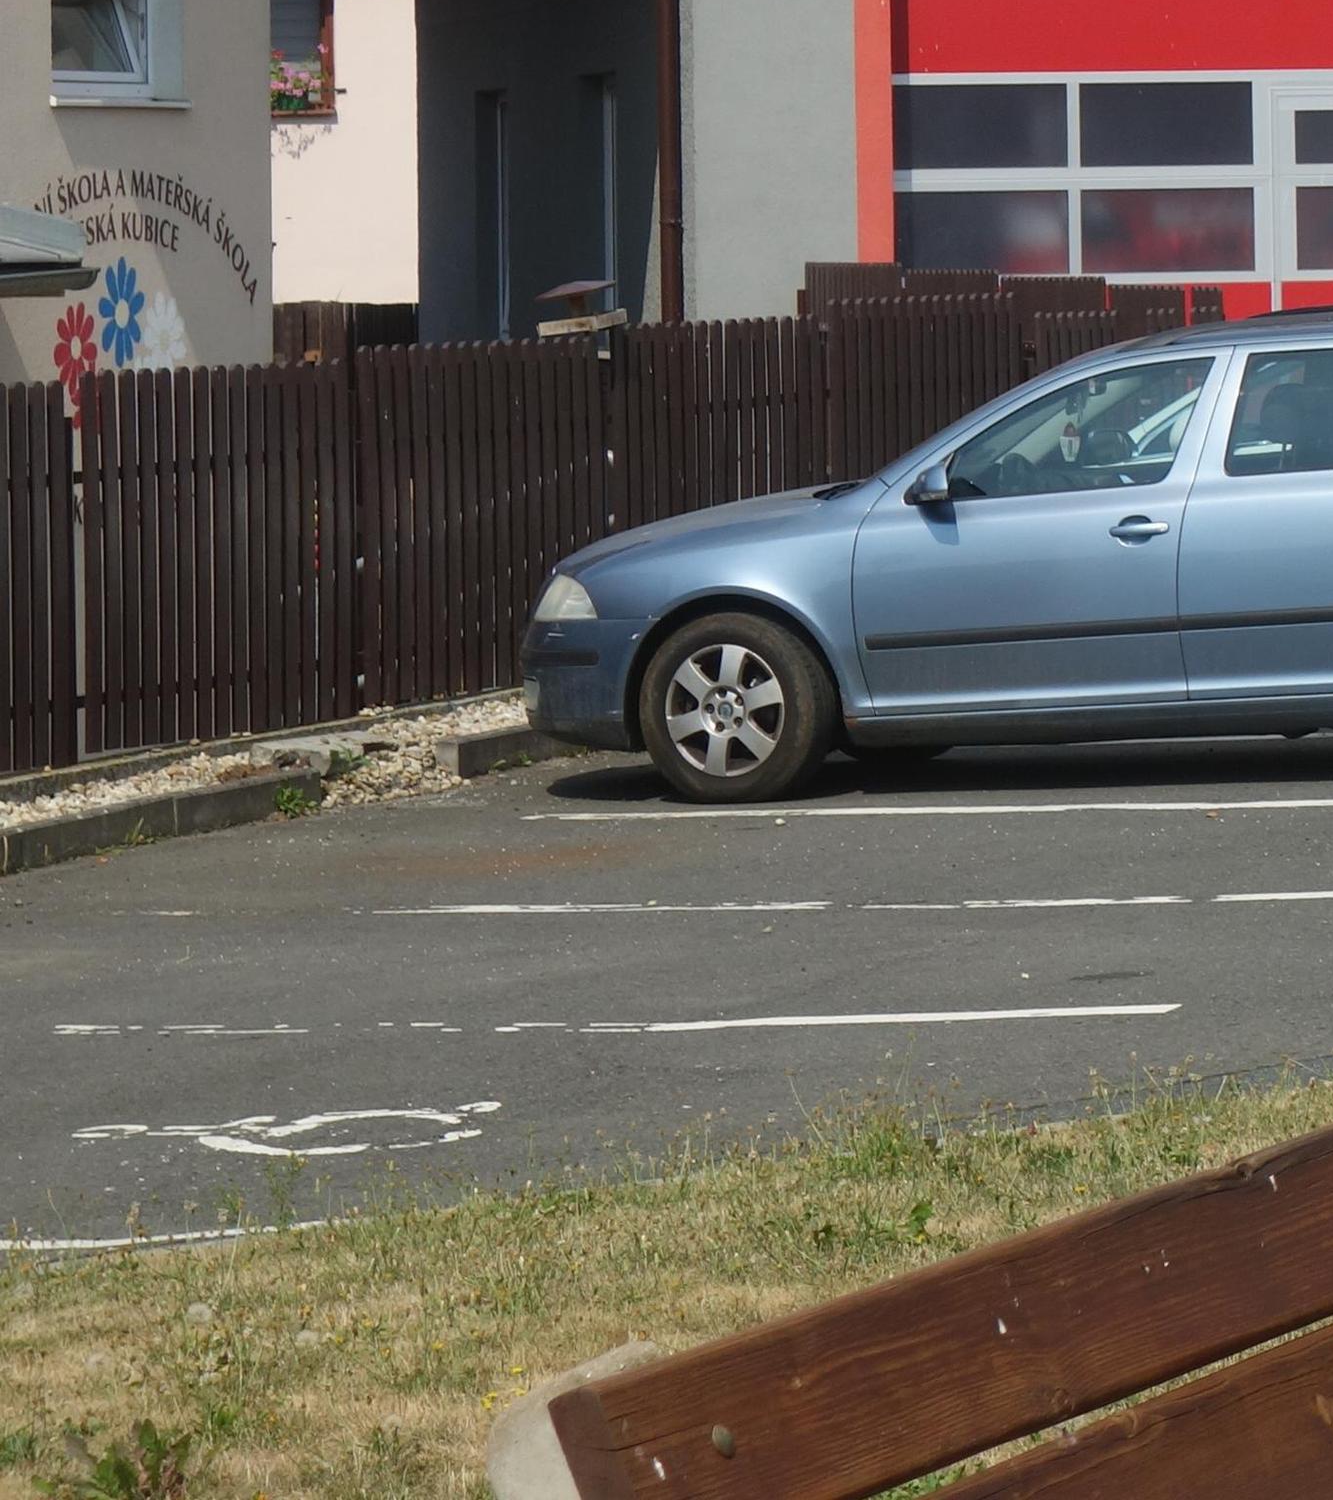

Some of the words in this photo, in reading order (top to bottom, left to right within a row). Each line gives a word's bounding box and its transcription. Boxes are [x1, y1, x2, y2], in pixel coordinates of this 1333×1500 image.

[57, 170, 111, 214] ŠKOLA
[115, 168, 126, 197] A
[130, 169, 214, 235] MATEŘSKÁ
[213, 209, 258, 306] ŠKOLA
[80, 203, 117, 246] SKÁ
[121, 211, 180, 252] KUBICE
